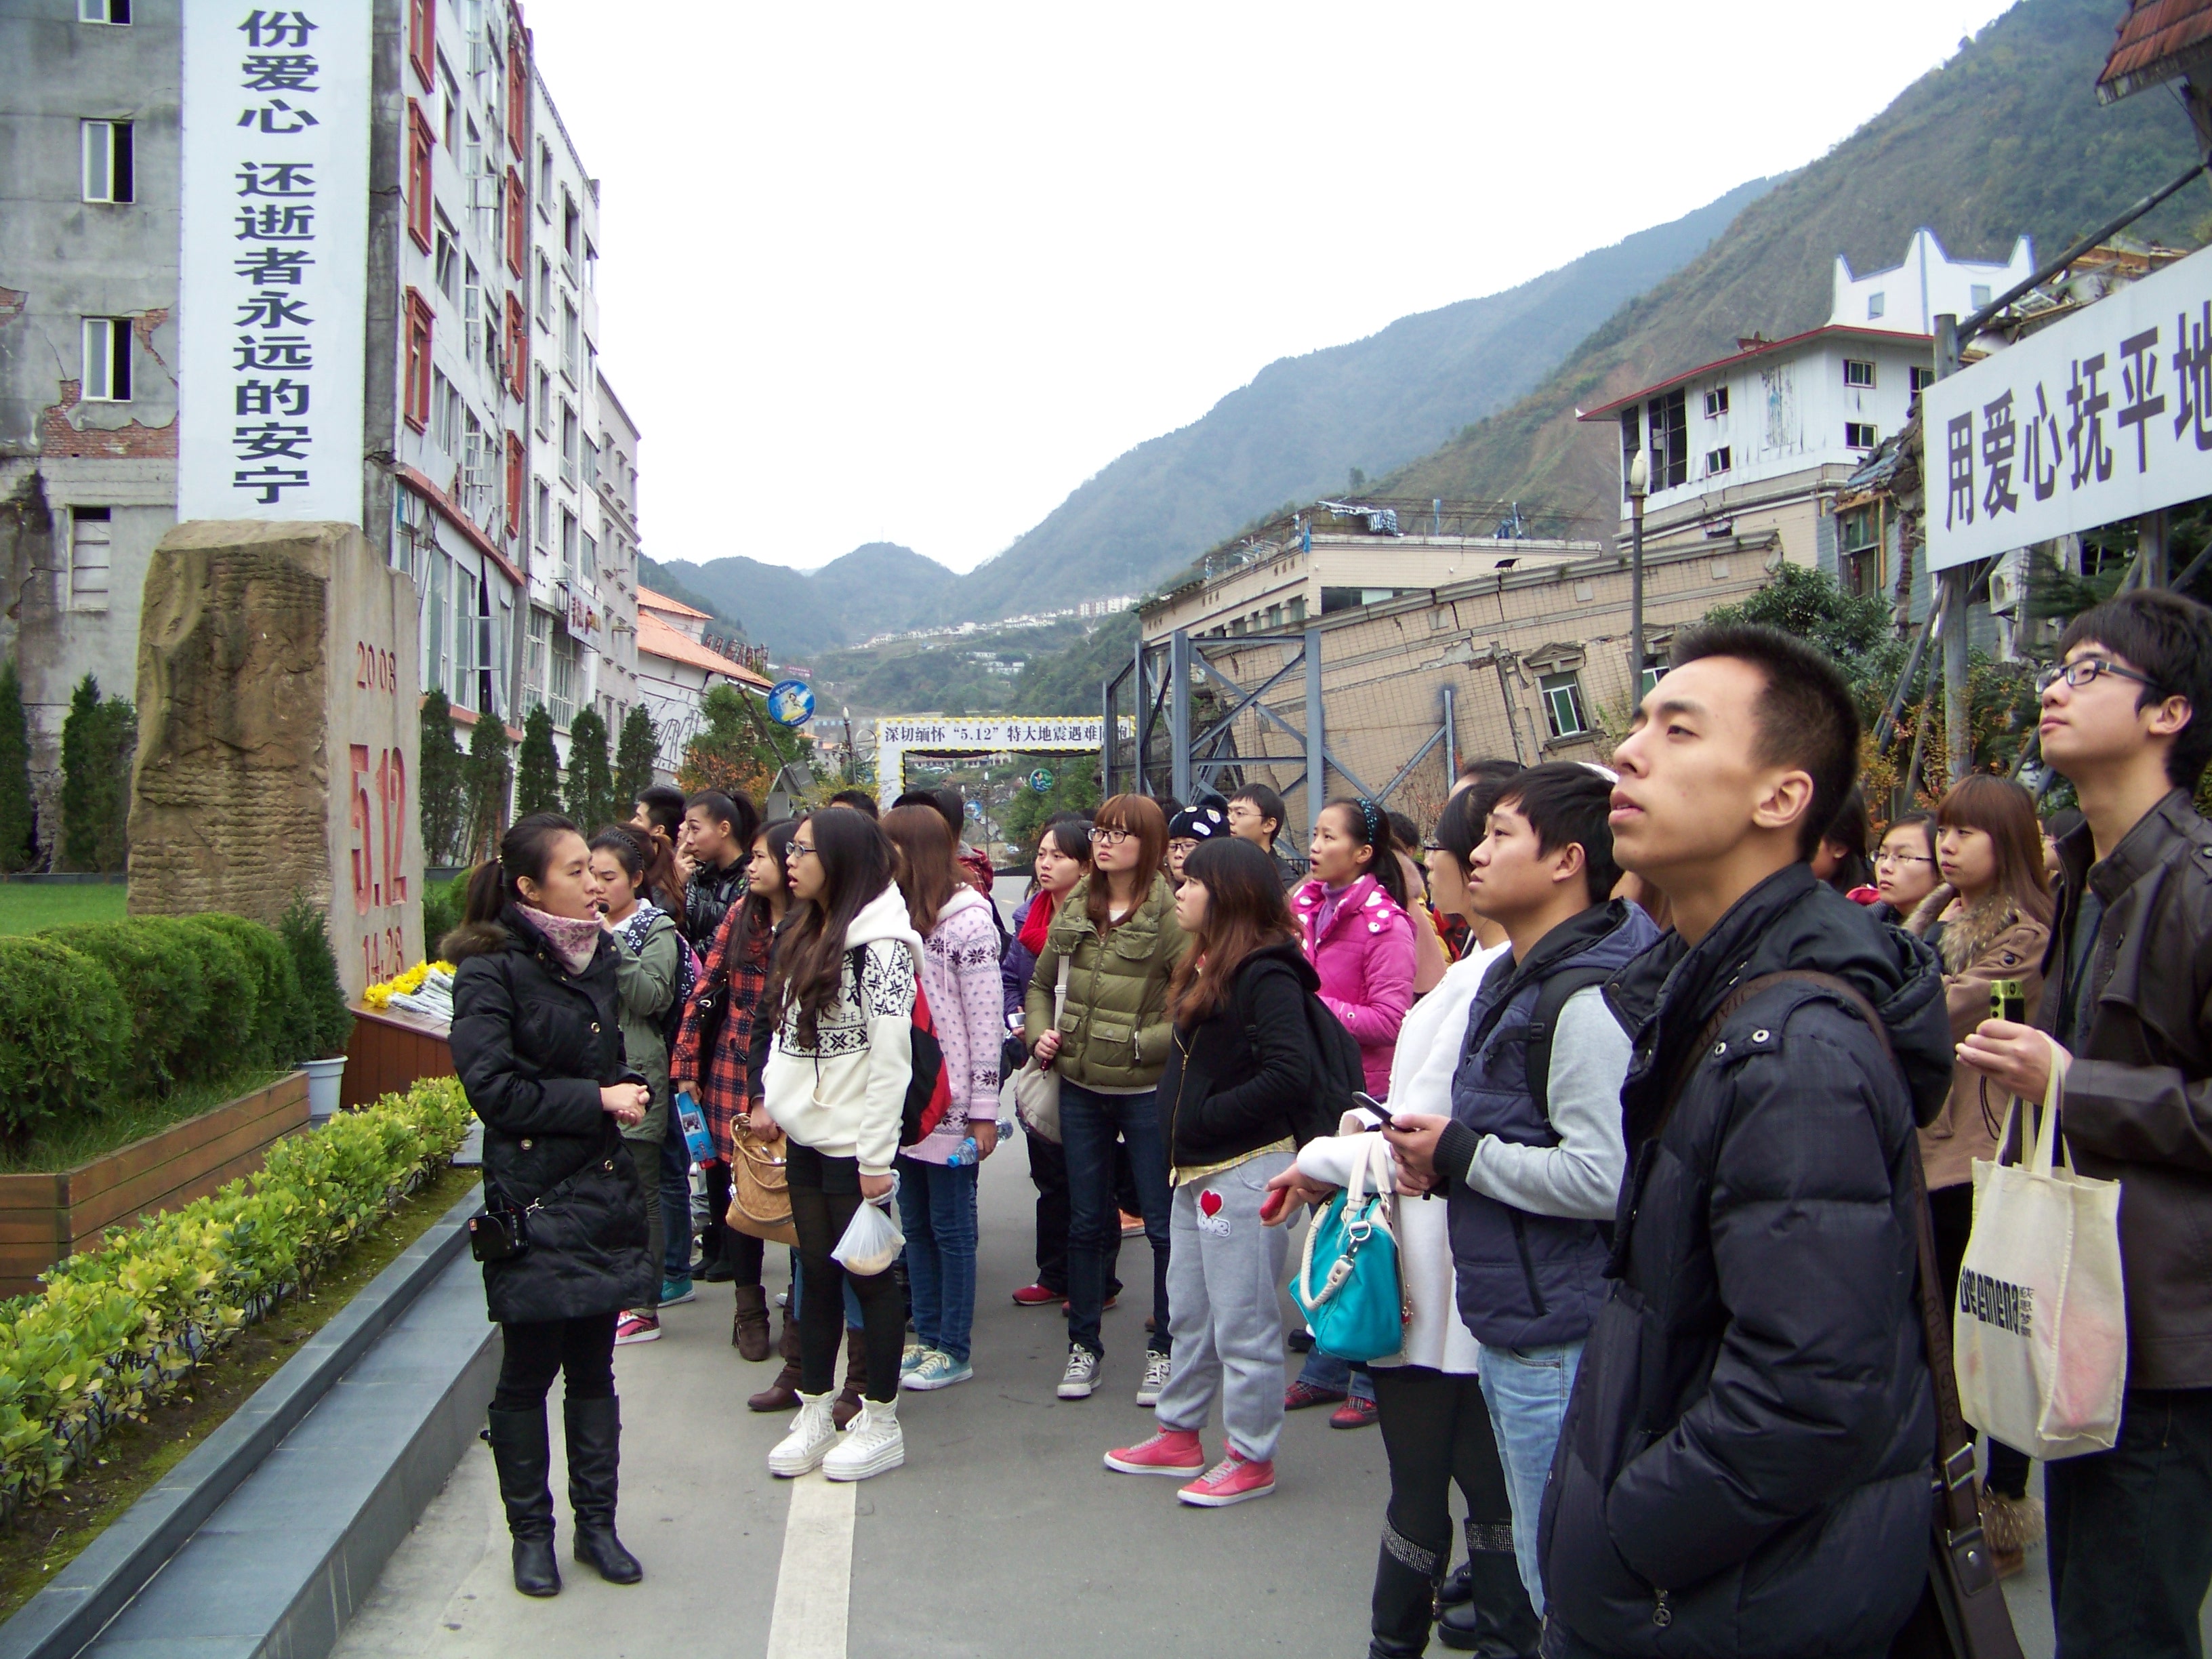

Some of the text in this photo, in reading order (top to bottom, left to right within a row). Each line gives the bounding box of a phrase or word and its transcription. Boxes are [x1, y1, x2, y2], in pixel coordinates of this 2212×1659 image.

[237, 9, 320, 134] 份爱心
[233, 162, 316, 504] 还逝者永远的安宁
[1945, 300, 2212, 532] 用爱心抚平地
[356, 640, 396, 696] 2008
[350, 743, 407, 916] 5.12
